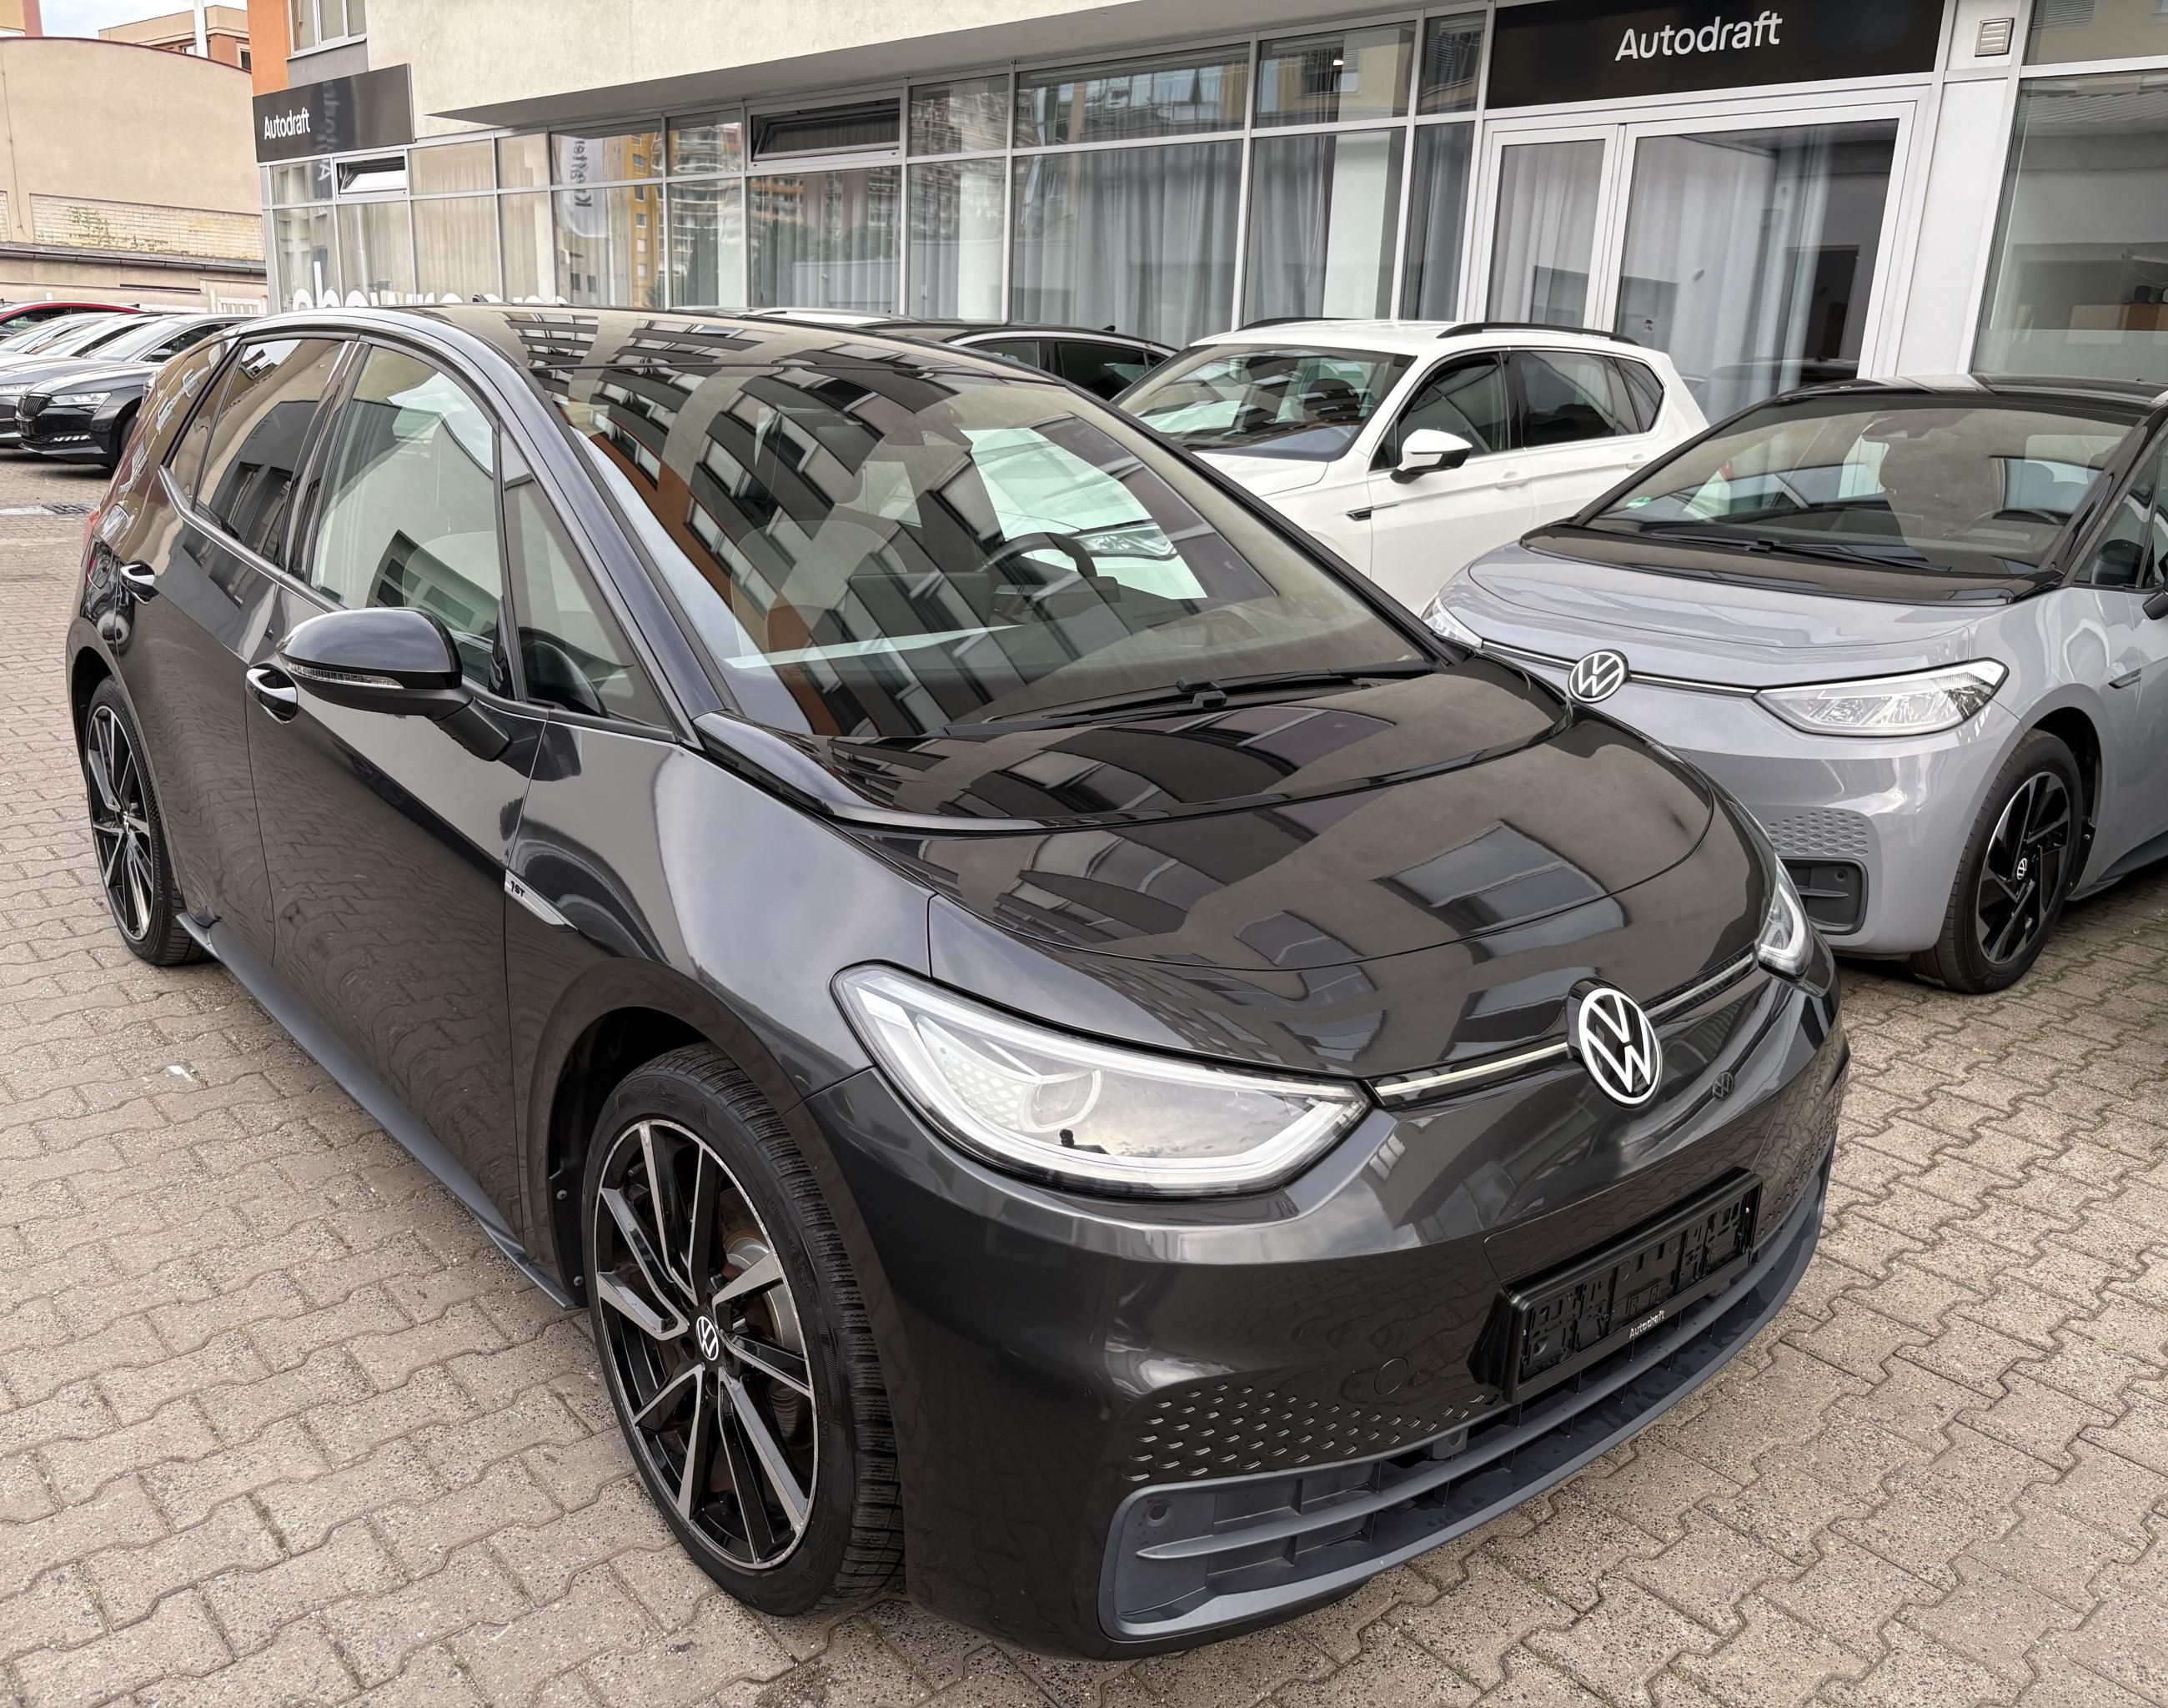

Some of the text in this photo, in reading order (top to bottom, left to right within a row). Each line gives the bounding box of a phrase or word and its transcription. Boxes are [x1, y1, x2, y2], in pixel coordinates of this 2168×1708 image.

[1614, 10, 1783, 61] Autodraft
[263, 107, 311, 140] Autodraft
[1568, 651, 1624, 702] VW
[510, 880, 525, 897] 1ST
[1578, 987, 1660, 1104] VW
[696, 1315, 719, 1360] VW
[1629, 1309, 1665, 1339] Autodraft
